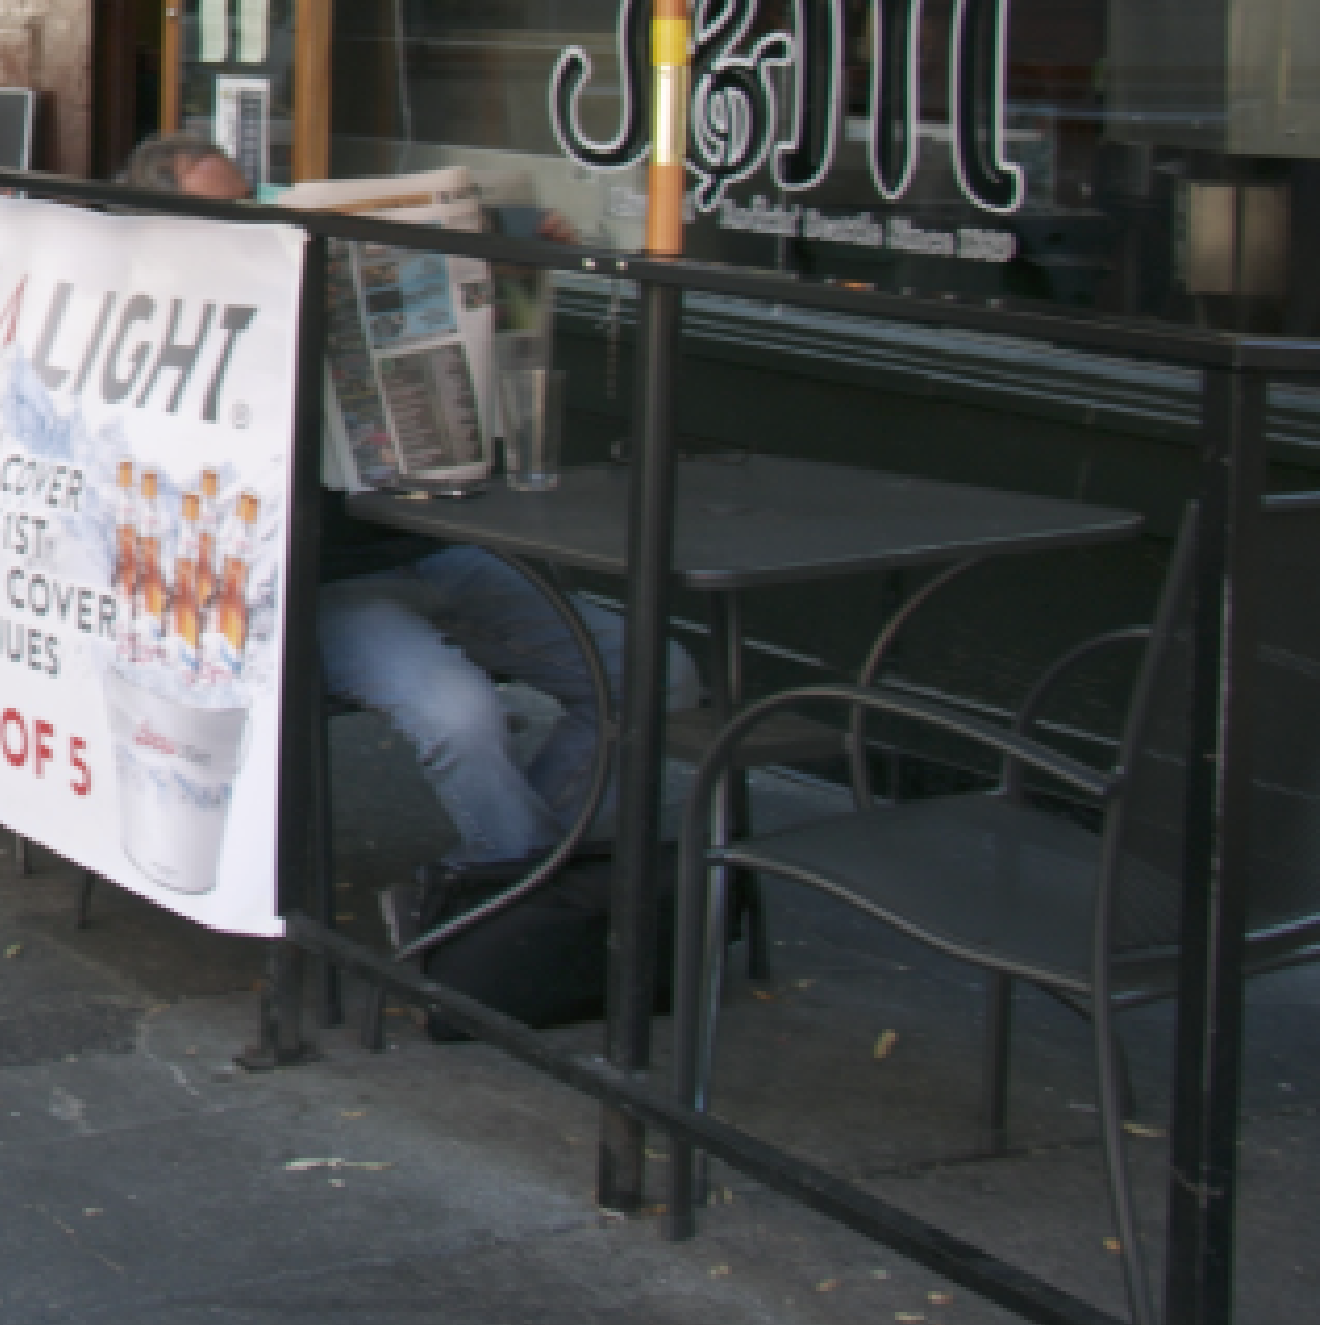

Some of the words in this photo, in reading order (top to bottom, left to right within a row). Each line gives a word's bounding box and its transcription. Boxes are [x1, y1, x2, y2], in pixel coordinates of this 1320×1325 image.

[32, 280, 258, 425] LIGHT
[0, 453, 86, 513] COVER
[6, 565, 120, 639] COVER
[67, 735, 93, 797] 5
